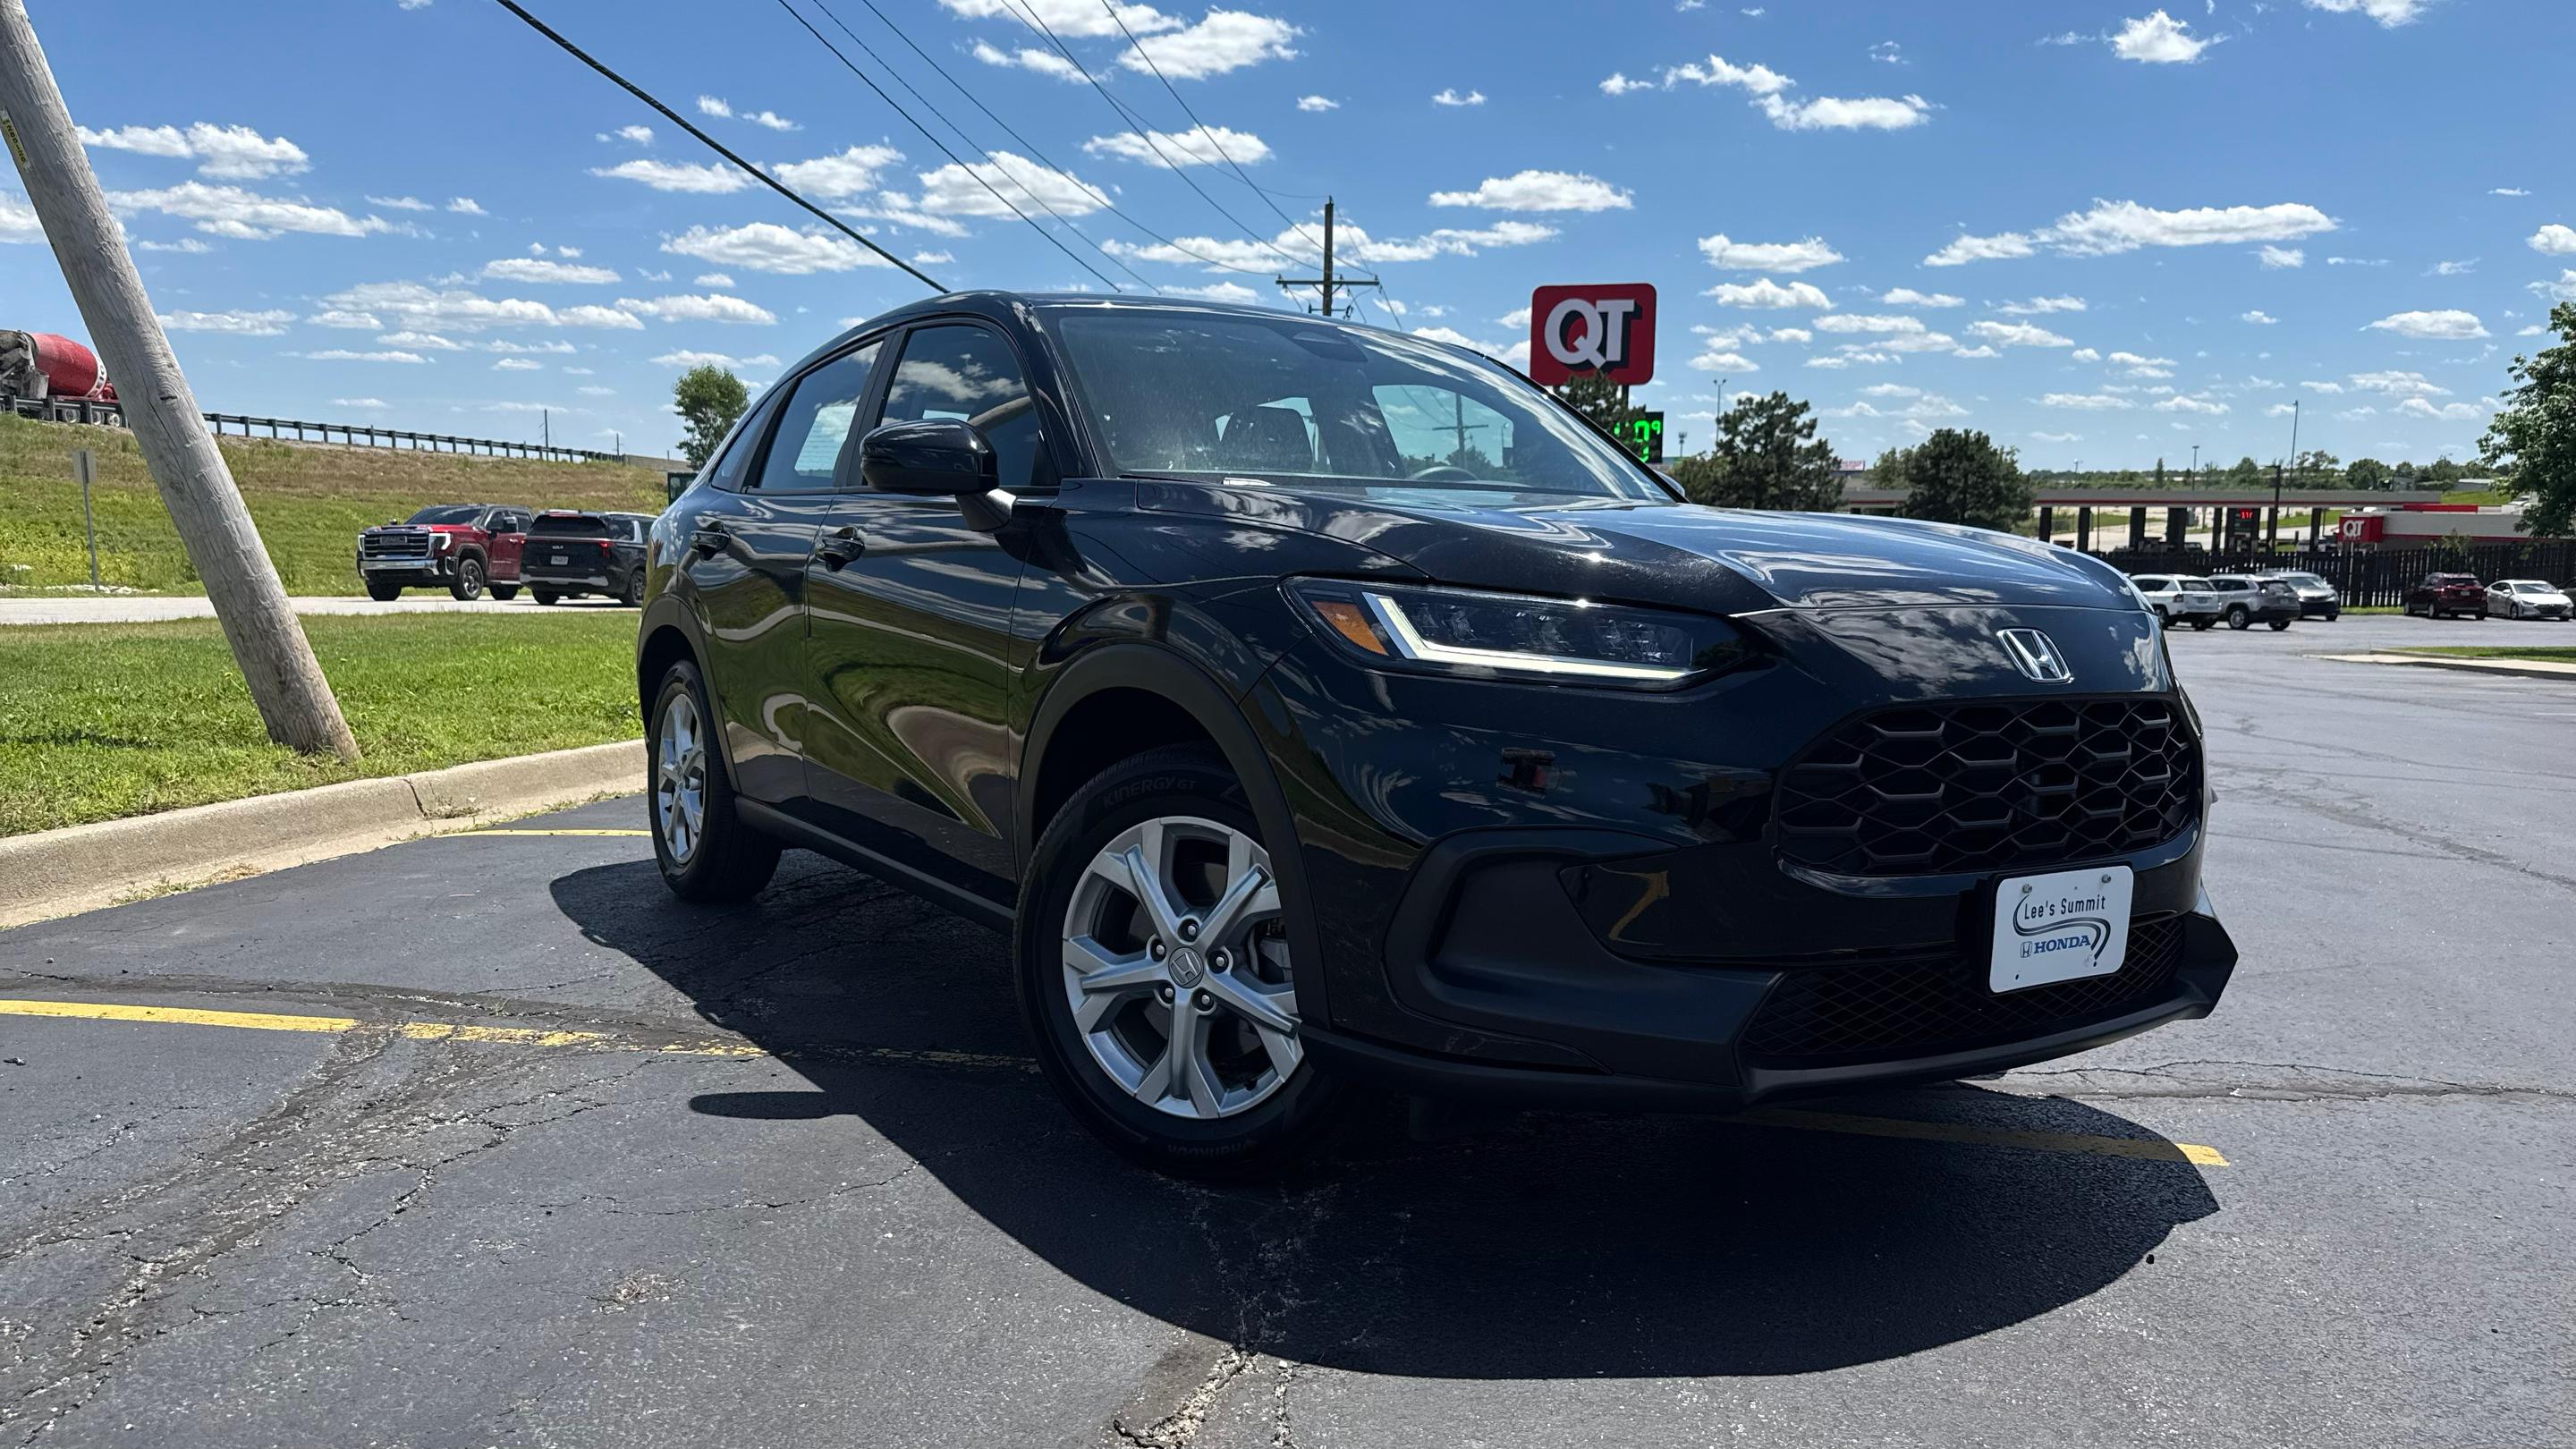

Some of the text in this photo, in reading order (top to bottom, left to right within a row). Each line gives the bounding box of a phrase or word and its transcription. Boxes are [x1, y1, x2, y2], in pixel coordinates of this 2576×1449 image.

[1544, 298, 1636, 369] QT
[2343, 520, 2365, 538] QT
[1102, 775, 1199, 809] KINERGY GT
[2024, 894, 2106, 919] Lee's Summit
[2033, 935, 2091, 954] HONDA
